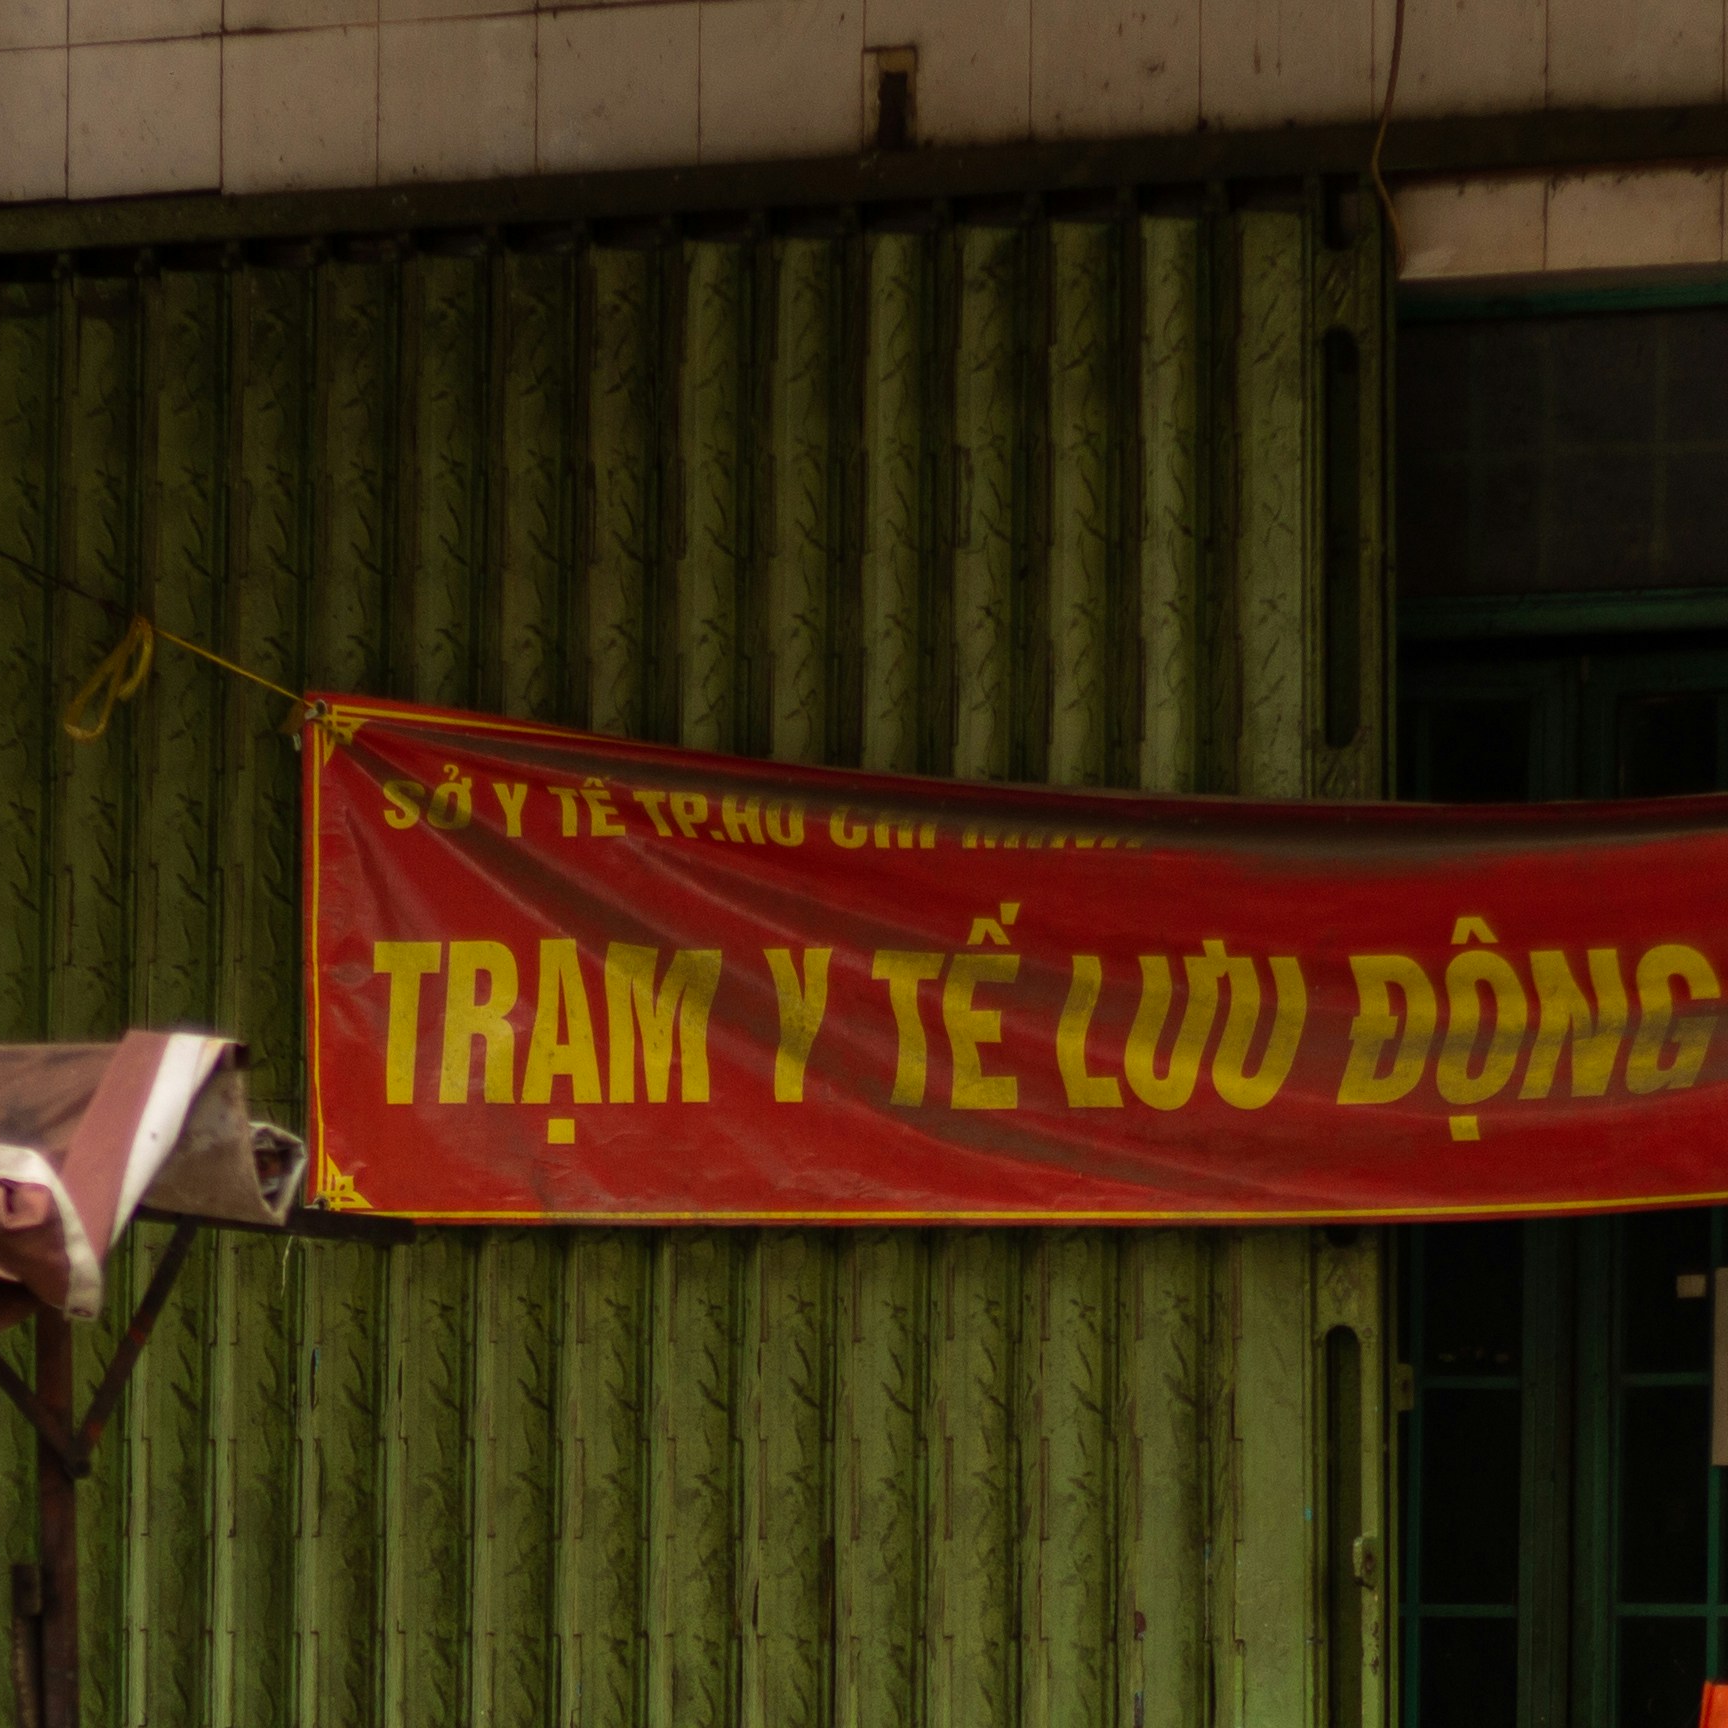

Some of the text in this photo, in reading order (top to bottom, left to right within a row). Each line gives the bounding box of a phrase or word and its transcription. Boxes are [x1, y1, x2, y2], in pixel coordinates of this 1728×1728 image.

[381, 763, 475, 832] SỞ
[491, 781, 529, 839] Y
[373, 936, 724, 1146] TRẠM
[763, 947, 834, 1104] Y
[870, 901, 1022, 1111] TẾ
[1054, 936, 1309, 1112] LƯU
[1336, 914, 1723, 1143] ĐỘNG
